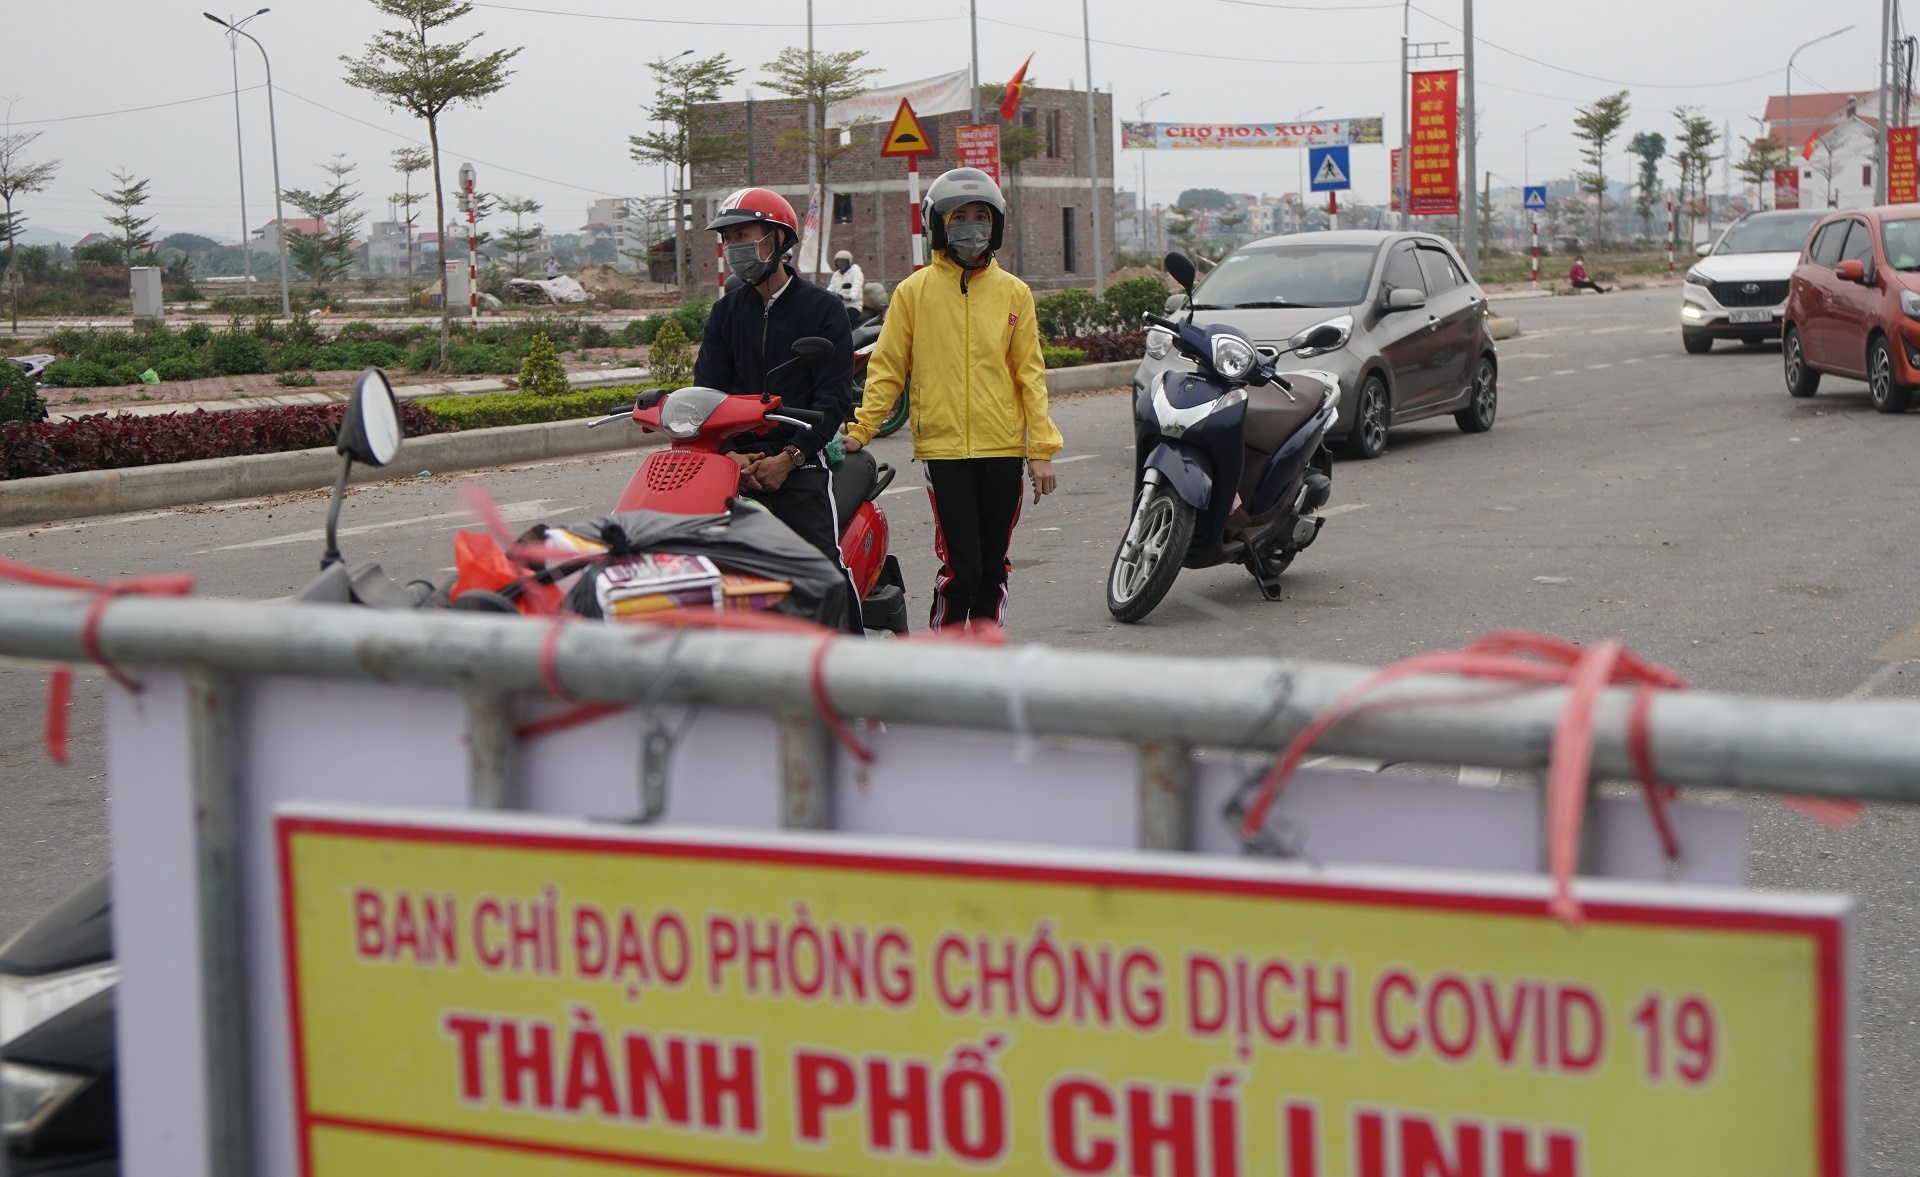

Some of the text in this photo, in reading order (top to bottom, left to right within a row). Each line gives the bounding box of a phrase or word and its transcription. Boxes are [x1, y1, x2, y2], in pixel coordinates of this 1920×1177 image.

[1165, 126, 1212, 140] CHỢ
[1219, 126, 1268, 137] HOA
[1184, 374, 1207, 382] HONDA
[355, 884, 1716, 1084] BAN CHỈ ĐẠO PHÒNG CHỐNG DỊCH COVID 19
[446, 1007, 759, 1134] THÀNH
[793, 1033, 1010, 1162] PHỐ
[1049, 1073, 1240, 1177] CHÍ
